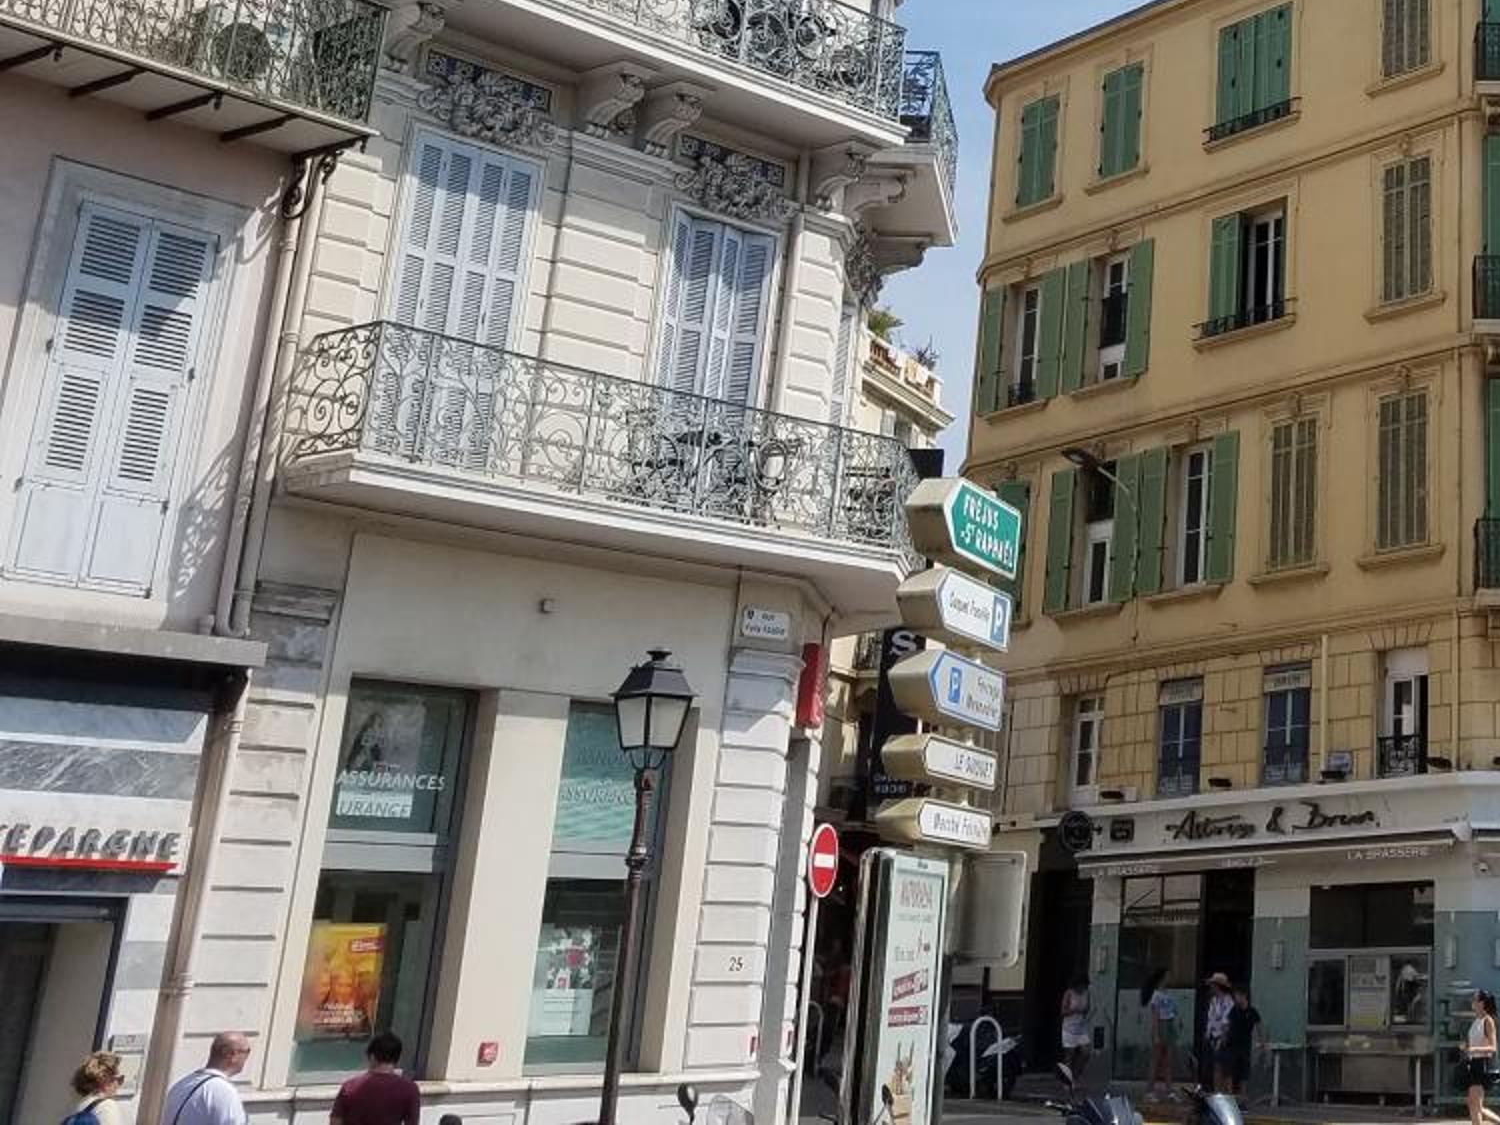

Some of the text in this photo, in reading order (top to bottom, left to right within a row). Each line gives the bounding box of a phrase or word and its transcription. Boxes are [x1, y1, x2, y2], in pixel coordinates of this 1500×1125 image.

[994, 603, 1003, 637] P
[336, 769, 446, 791] ASSURANCES
[729, 956, 743, 972] 25
